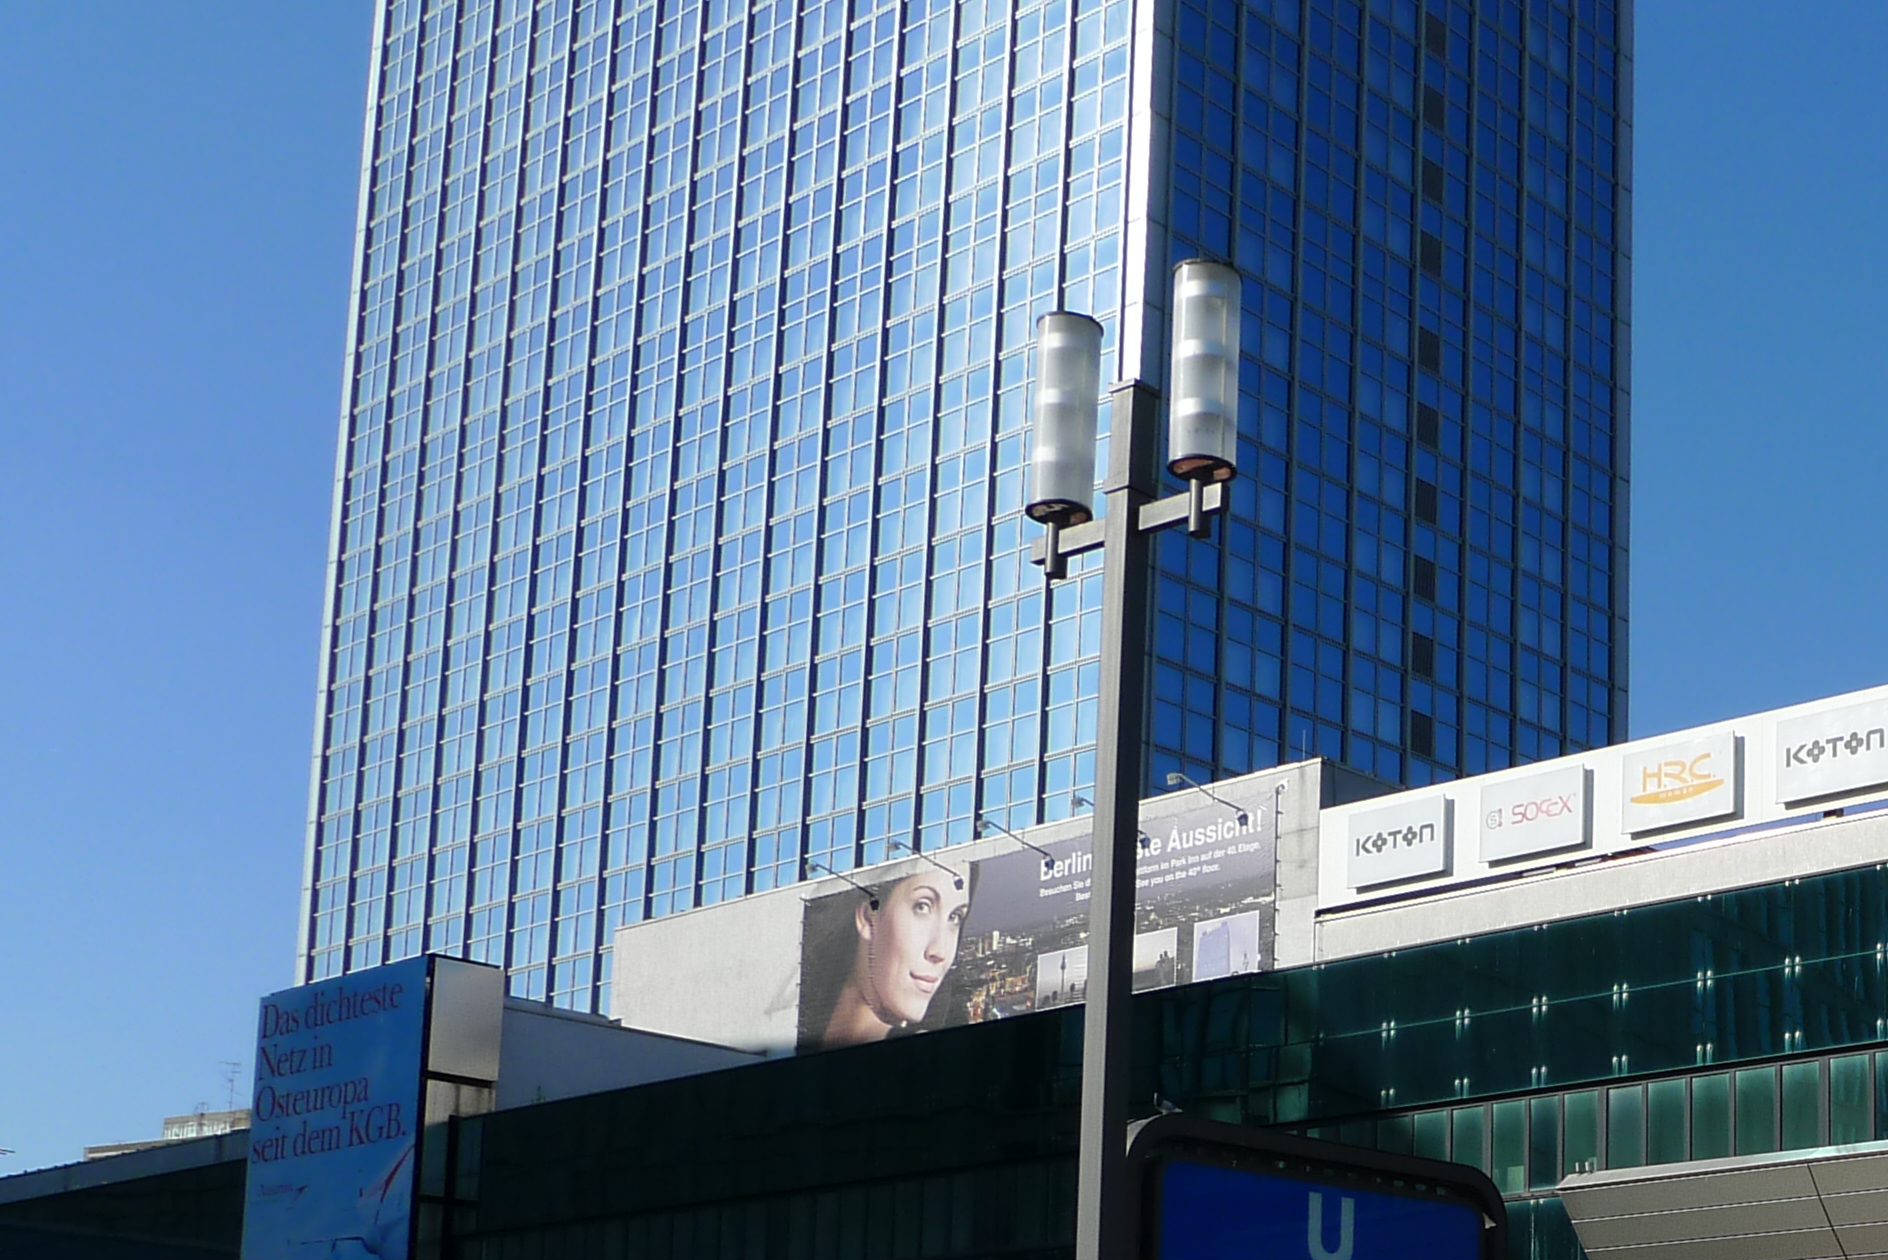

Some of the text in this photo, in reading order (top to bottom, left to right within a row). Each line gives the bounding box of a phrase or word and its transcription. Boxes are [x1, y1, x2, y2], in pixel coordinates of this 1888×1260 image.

[261, 983, 403, 1040] Das dichteste
[258, 1035, 333, 1081] Netz in
[255, 1077, 370, 1122] Osteuropa
[251, 1126, 288, 1165] seit
[292, 1121, 341, 1158] dem
[347, 1102, 407, 1148] KGB.
